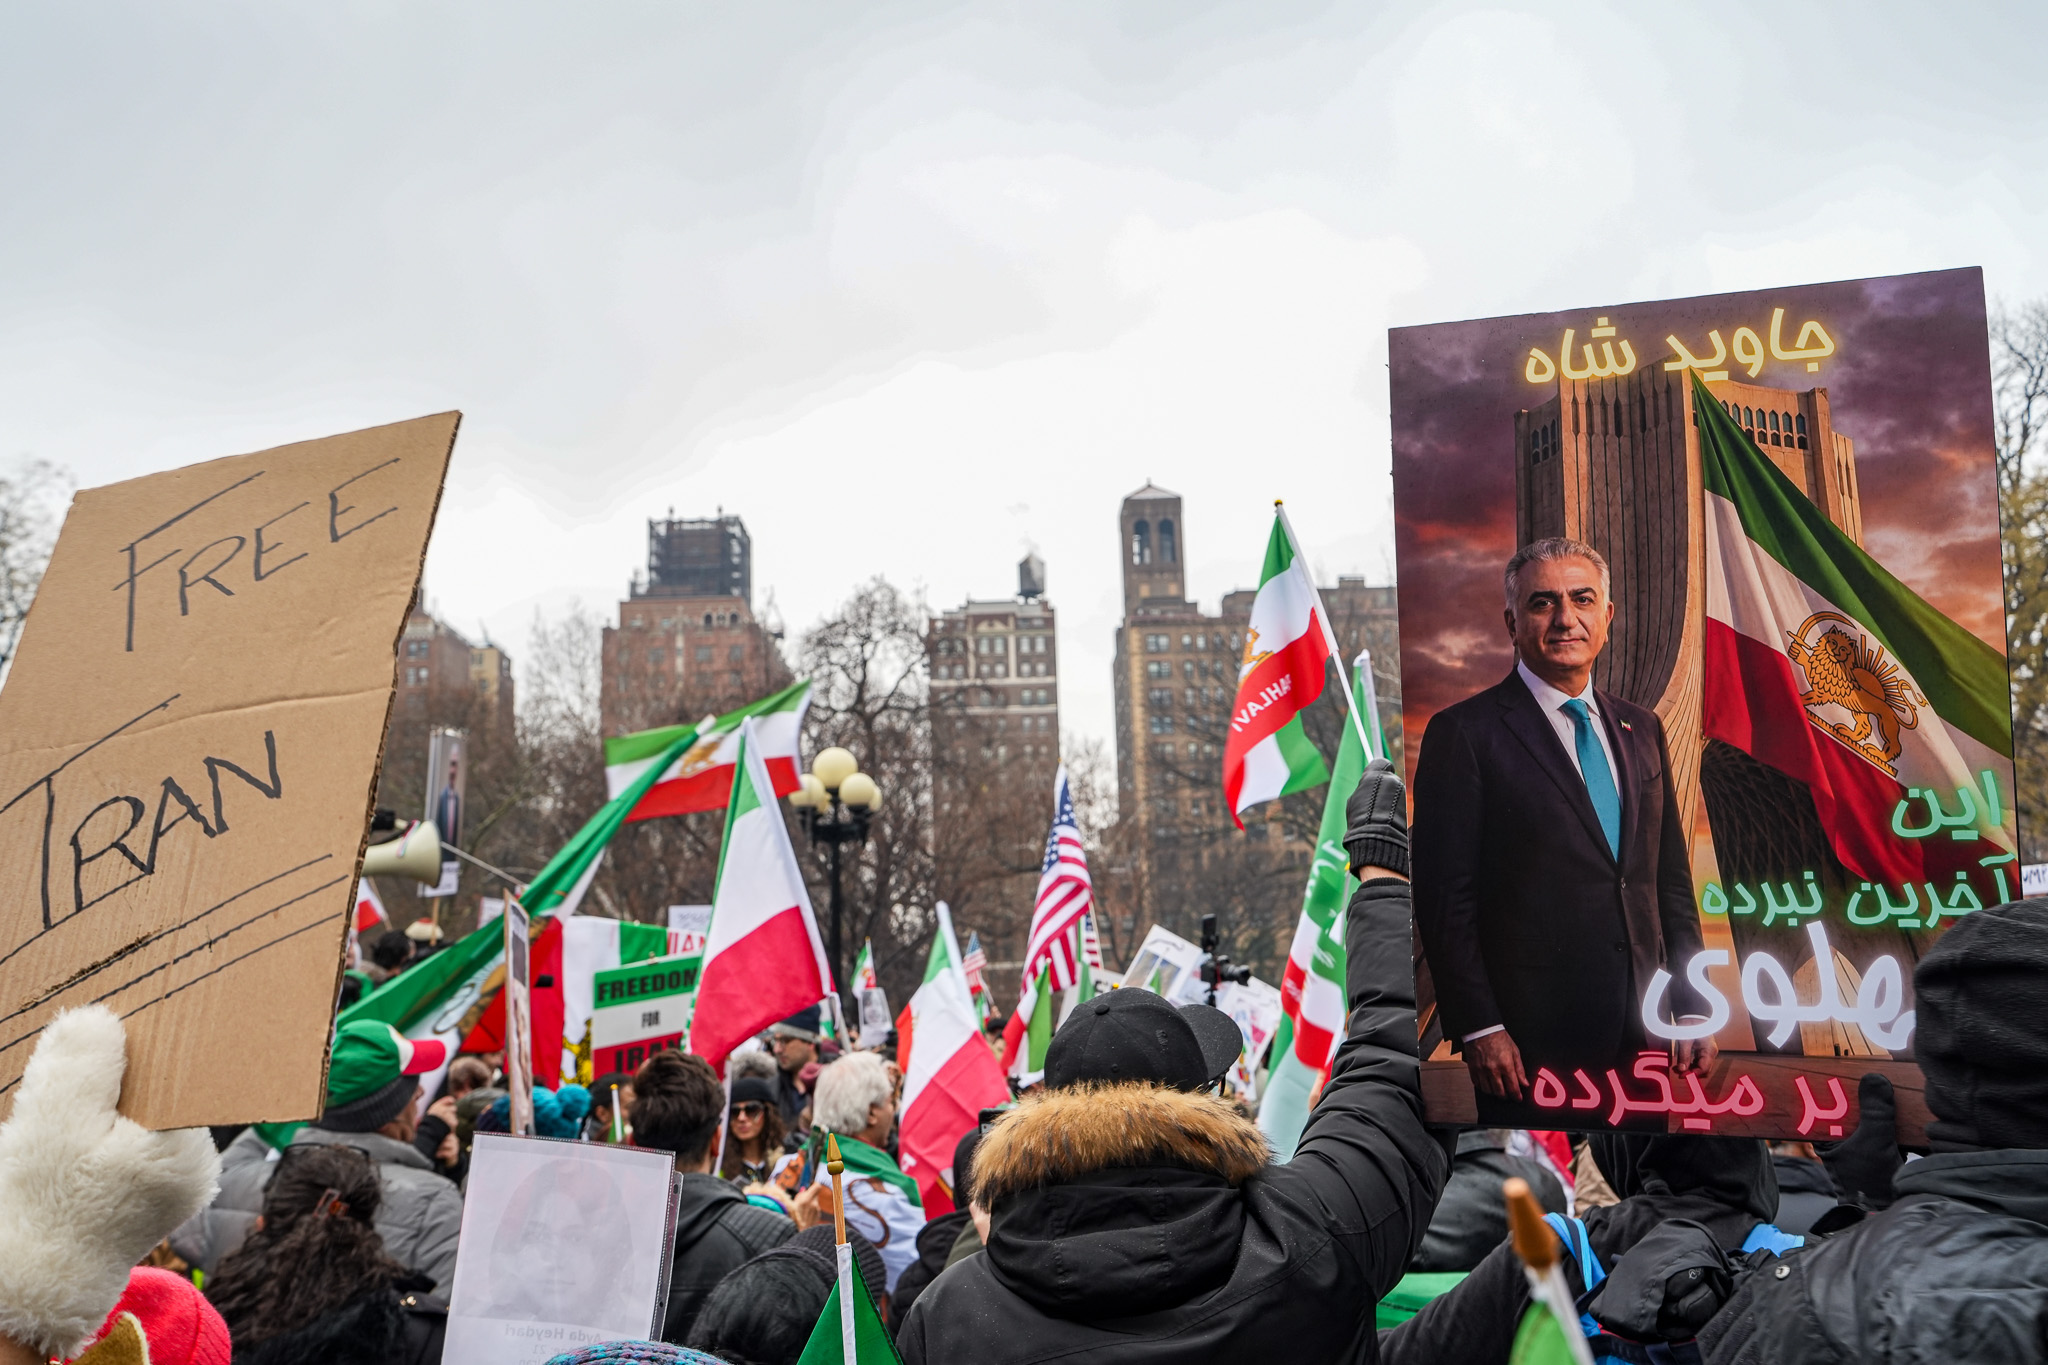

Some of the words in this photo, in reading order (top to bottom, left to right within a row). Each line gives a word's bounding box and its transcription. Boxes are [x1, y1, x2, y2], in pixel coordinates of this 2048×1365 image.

[1525, 317, 1637, 383] شاه
[1664, 308, 1834, 382] جاوید
[113, 458, 401, 652] FREE
[0, 693, 281, 963] IRAN
[1892, 770, 2001, 840] این
[1702, 871, 1823, 927] نبرده
[641, 1010, 660, 1028] FOR
[1642, 920, 1916, 1050] هلوی
[1797, 1075, 1849, 1136] بر
